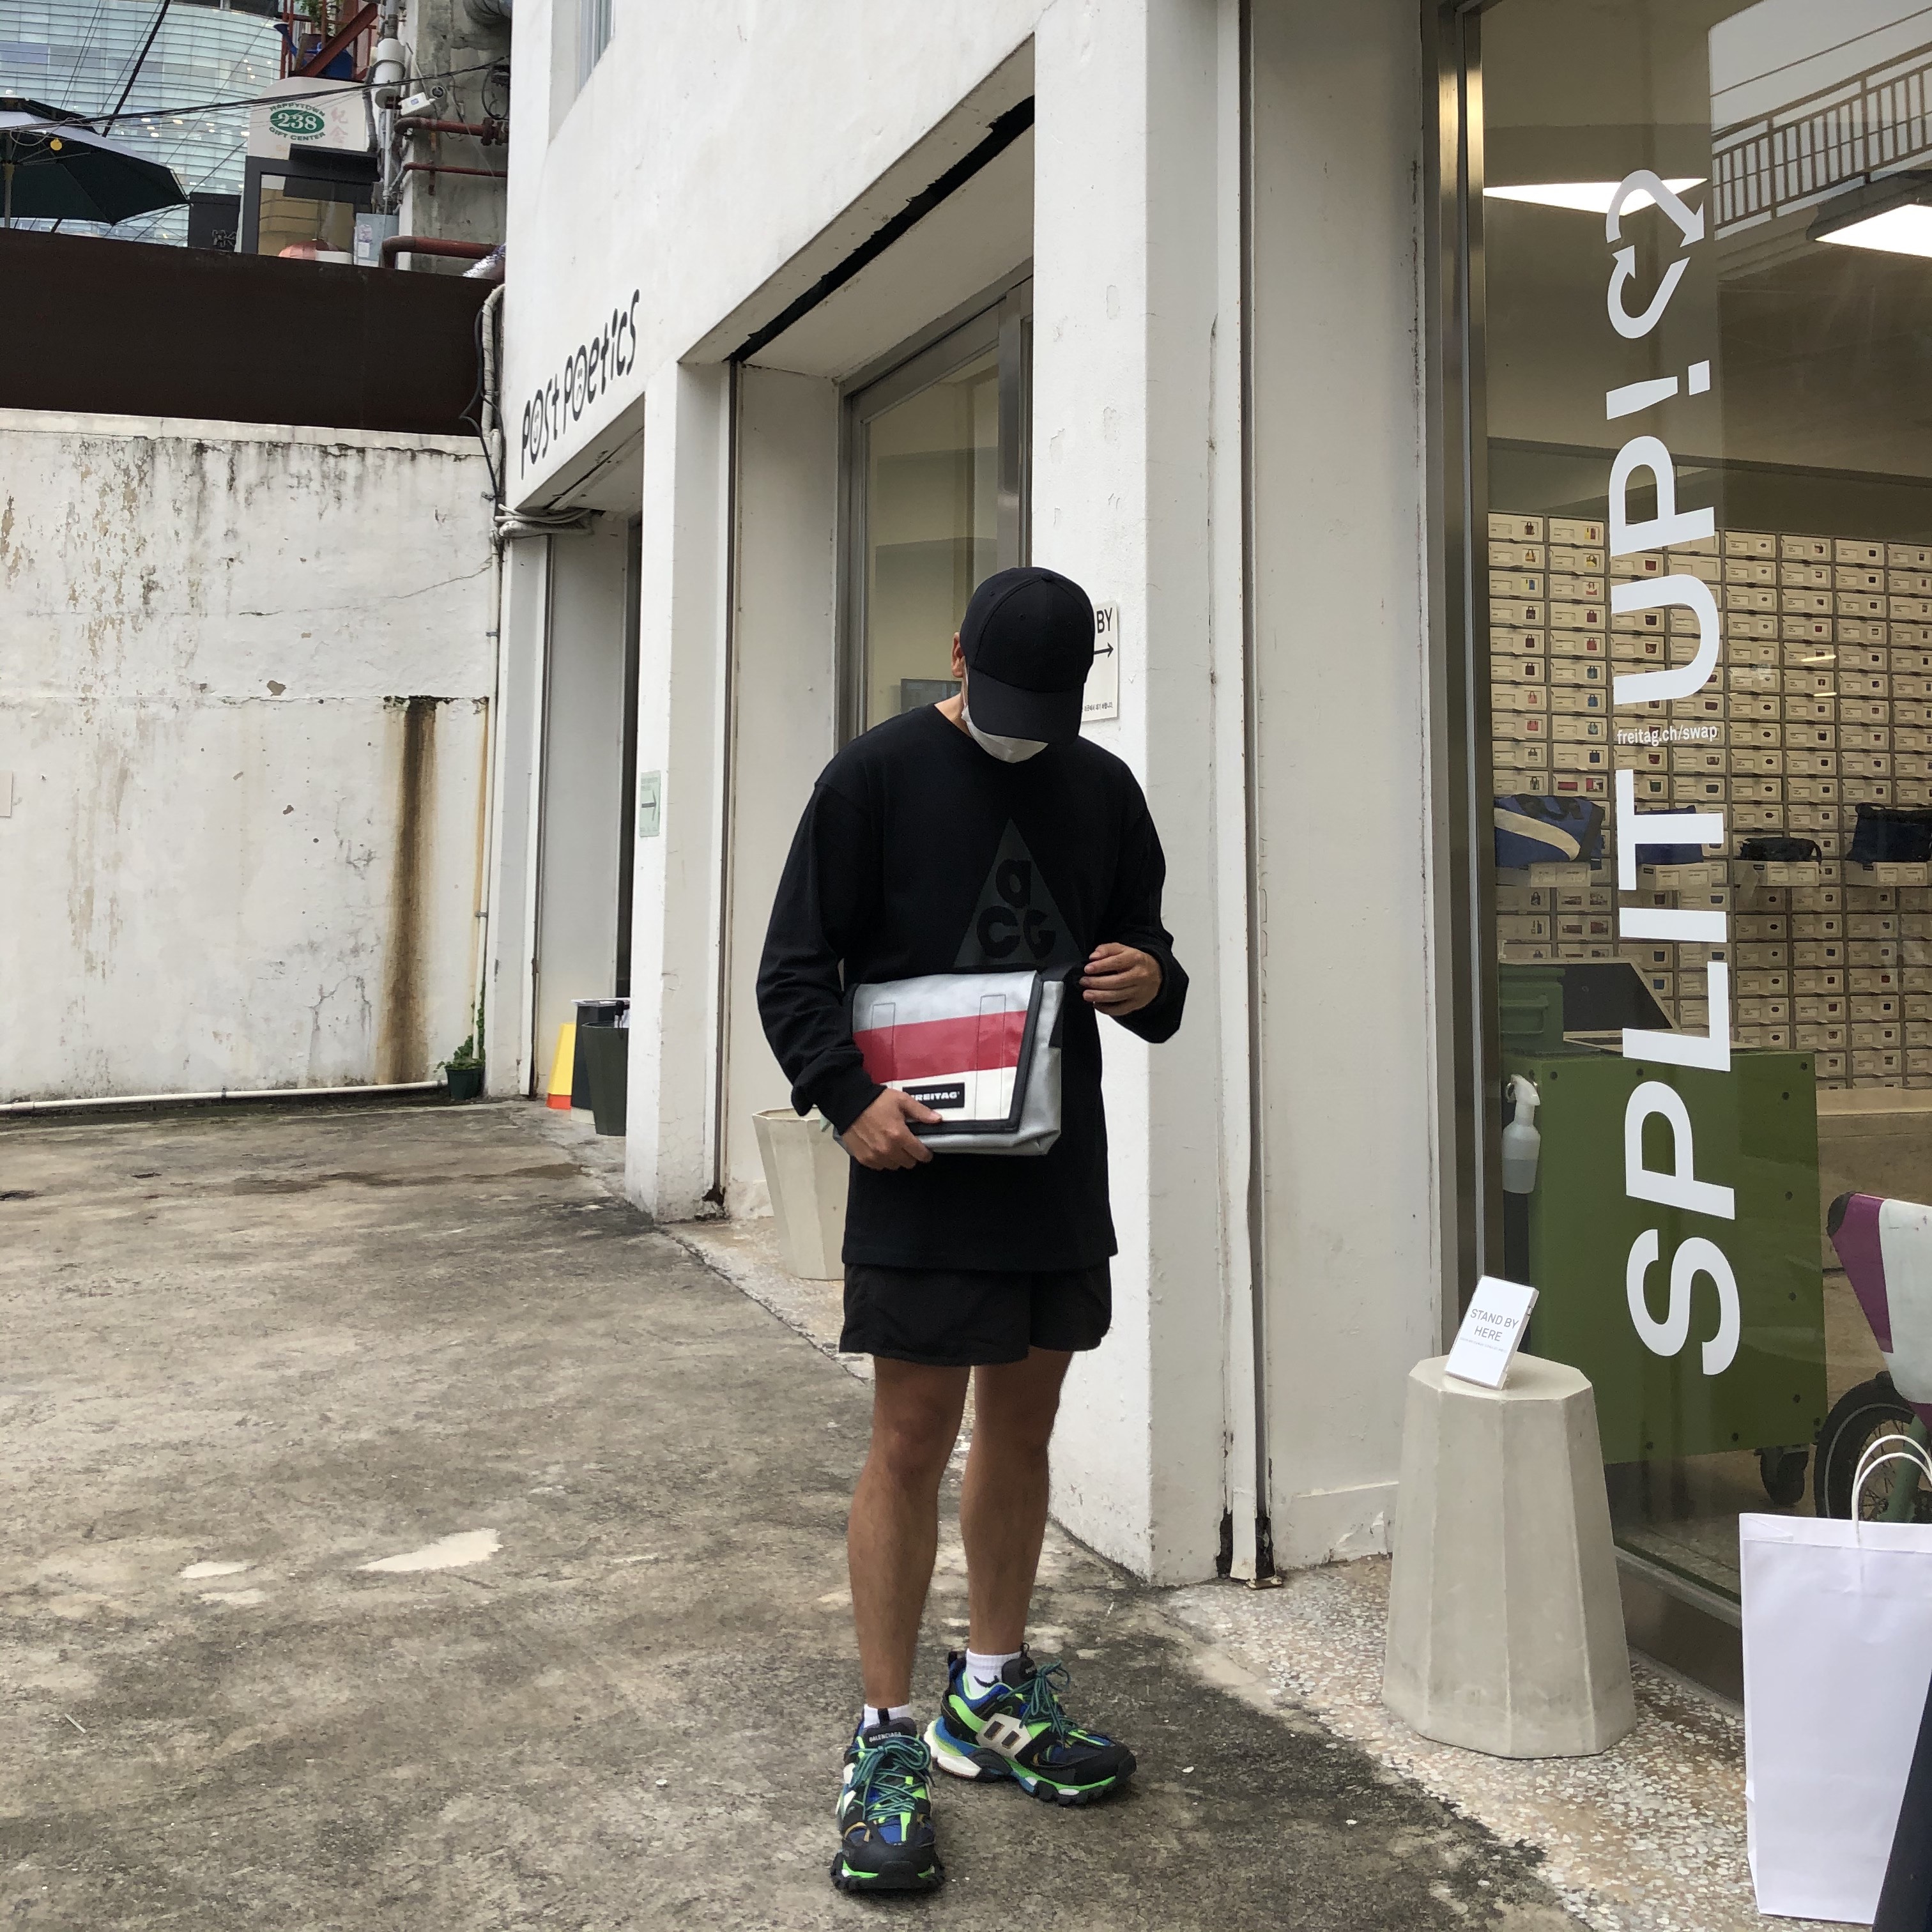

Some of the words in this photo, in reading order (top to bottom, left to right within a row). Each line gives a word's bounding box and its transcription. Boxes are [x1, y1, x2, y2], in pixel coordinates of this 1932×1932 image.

[277, 112, 318, 130] 238
[268, 126, 288, 138] GIFT
[290, 132, 326, 141] CENTER
[1096, 607, 1113, 634] BY
[1616, 724, 1717, 747] freitag.ch/swap
[1616, 769, 1740, 1375] SPLIT
[1470, 1308, 1503, 1326] STAND
[1504, 1317, 1519, 1330] BY
[1473, 1325, 1503, 1342] HERE
